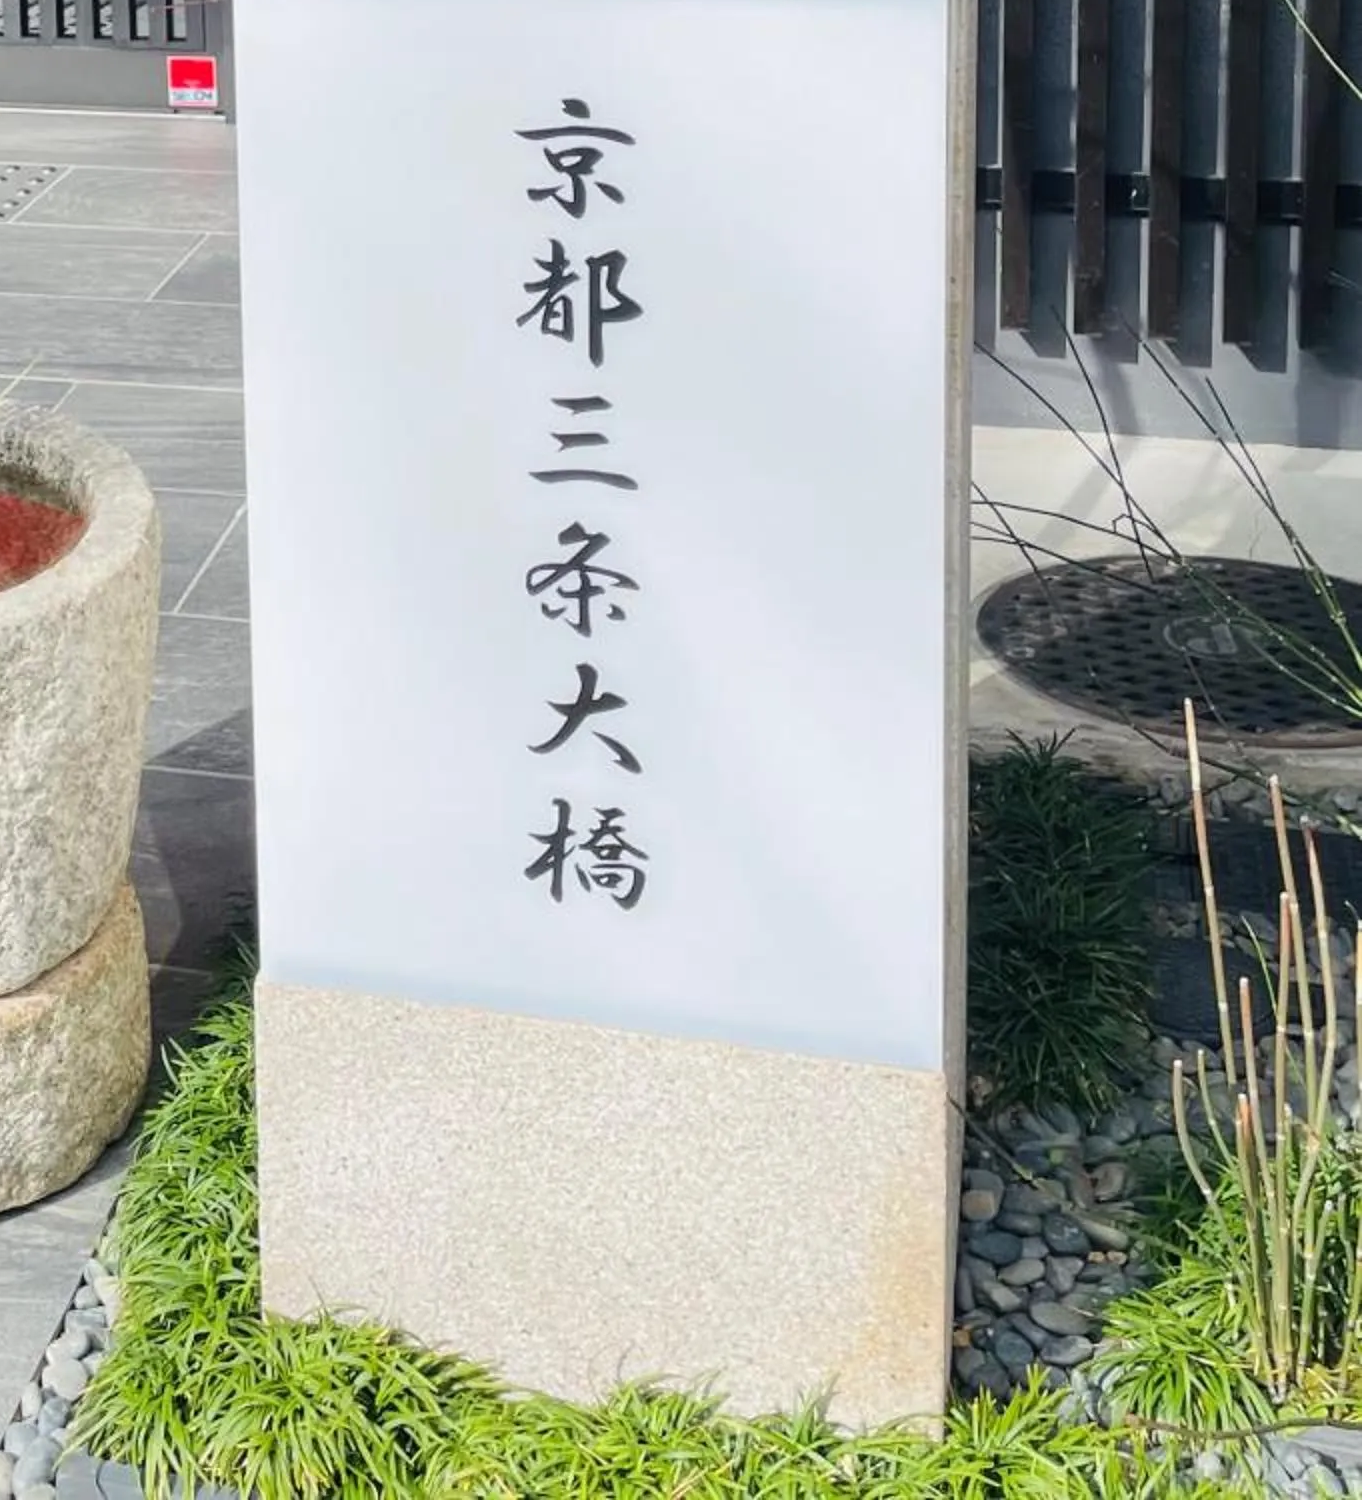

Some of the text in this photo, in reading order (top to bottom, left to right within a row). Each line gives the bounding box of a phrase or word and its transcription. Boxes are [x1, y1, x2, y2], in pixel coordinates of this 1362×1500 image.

[515, 97, 649, 911] 京都三条大橋
